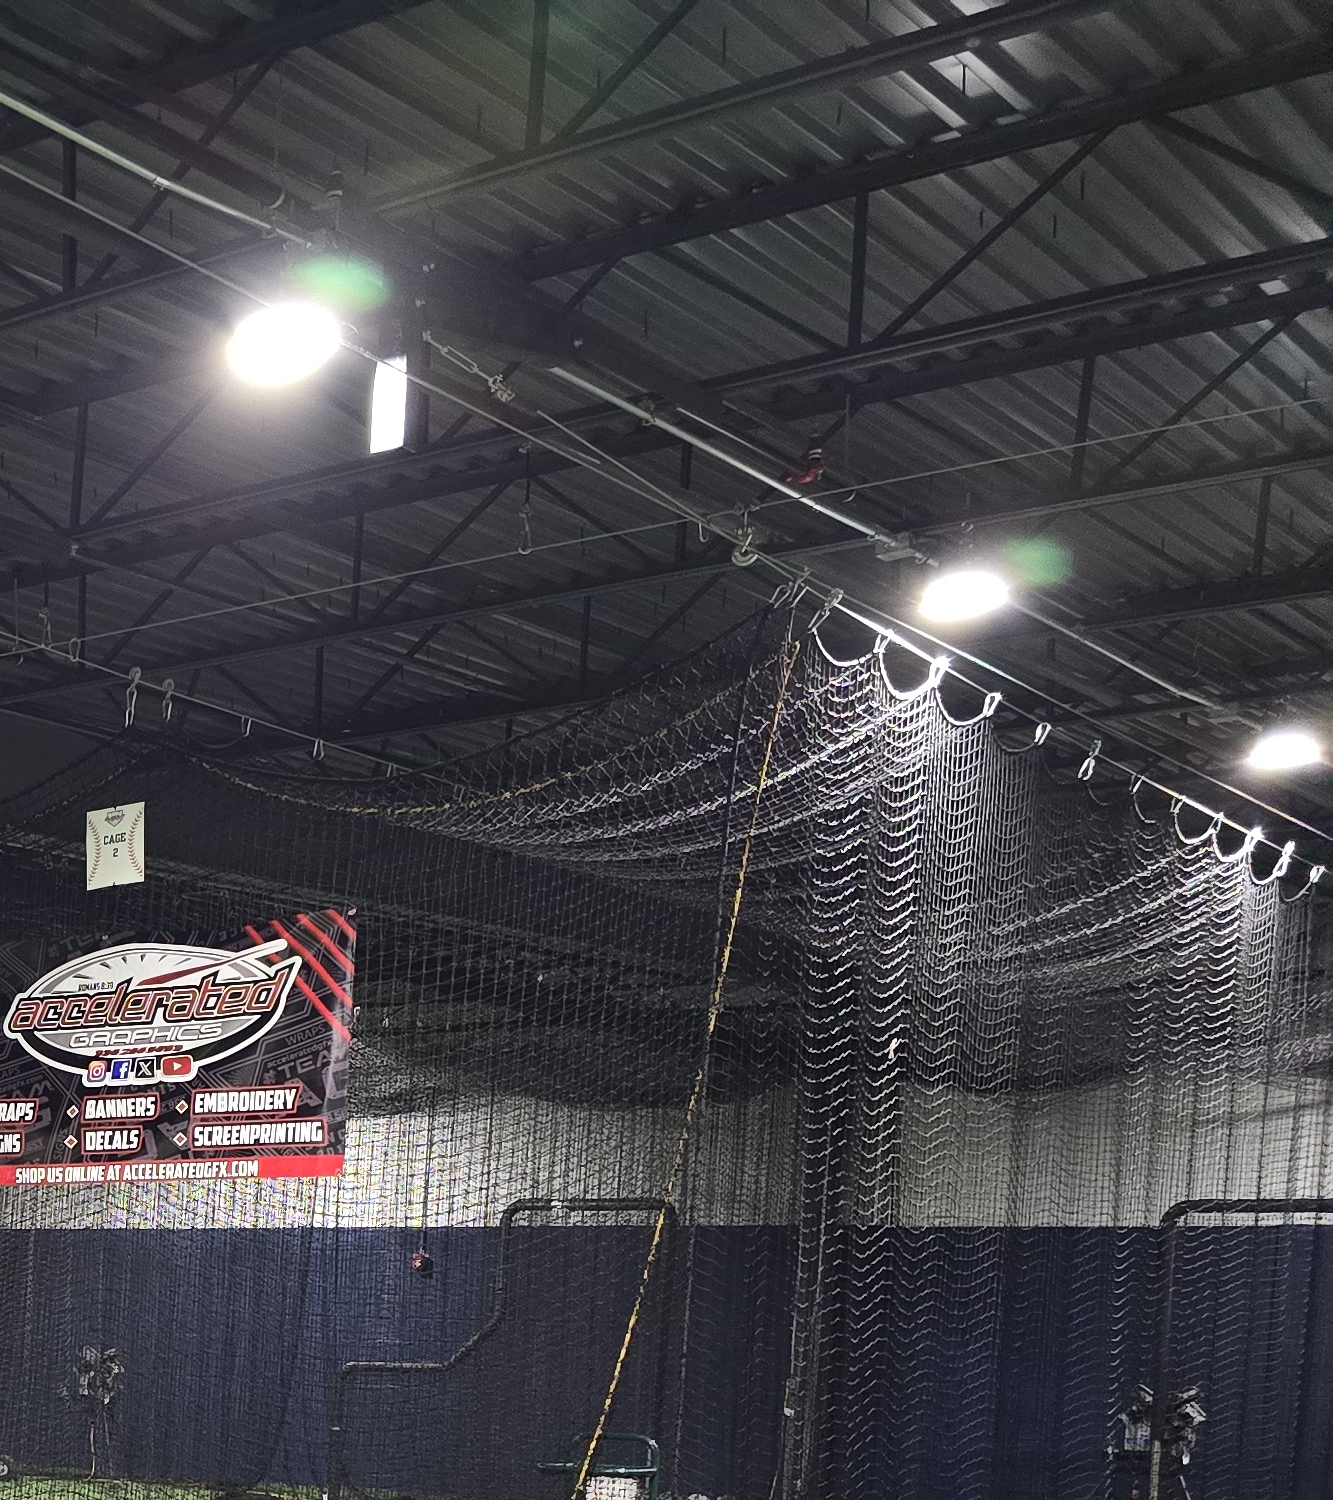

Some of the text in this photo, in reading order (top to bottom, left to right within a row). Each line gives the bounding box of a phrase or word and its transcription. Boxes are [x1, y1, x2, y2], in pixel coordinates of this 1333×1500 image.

[103, 832, 127, 846] CAGE
[112, 848, 119, 858] 2
[11, 970, 290, 1030] accelerated
[70, 1022, 222, 1048] GRAPHICS
[285, 1024, 326, 1046] WRAPS
[85, 1097, 156, 1119] BANNERS
[194, 1088, 297, 1113] EMBROIDERY
[85, 1129, 139, 1151] DECALS
[194, 1122, 323, 1147] SCREENPRINTING
[15, 1160, 259, 1184] SHOP US ONLINE AT ACCELERATEDGFX.COM
